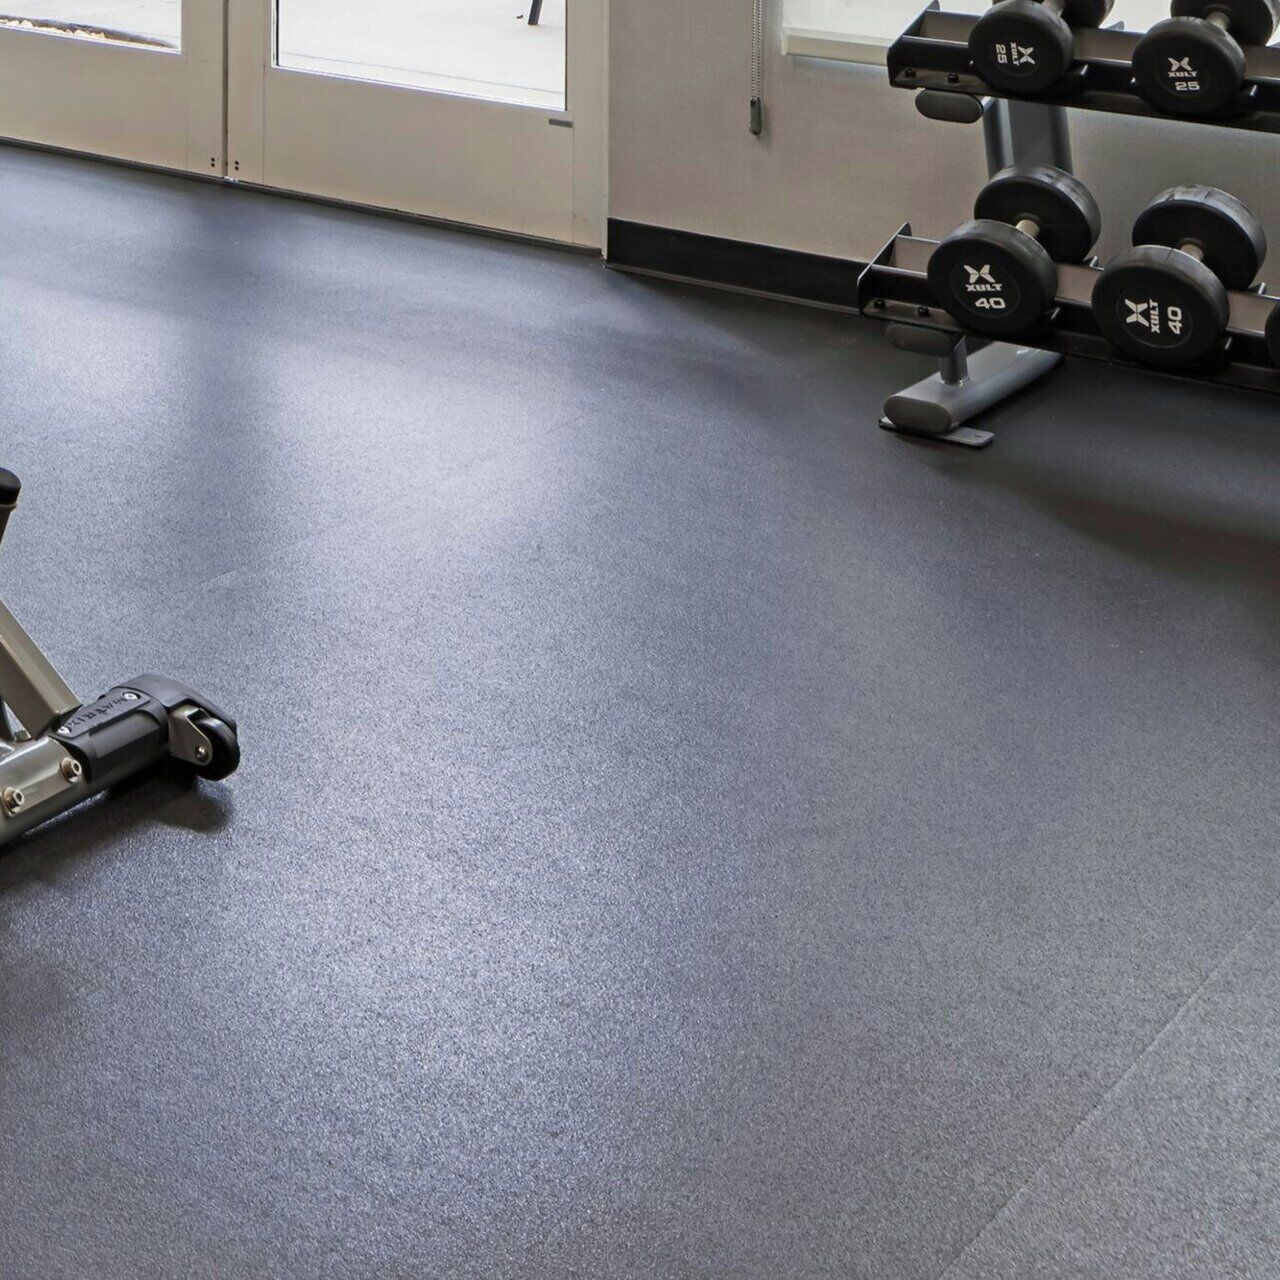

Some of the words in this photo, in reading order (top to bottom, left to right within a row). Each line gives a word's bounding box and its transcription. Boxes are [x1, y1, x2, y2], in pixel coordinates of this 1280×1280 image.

[996, 44, 1008, 64] 25
[1175, 81, 1200, 90] 25
[965, 283, 1002, 291] XULT
[975, 297, 1006, 309] 40
[1150, 299, 1160, 333] XULT
[1167, 306, 1182, 334] 40
